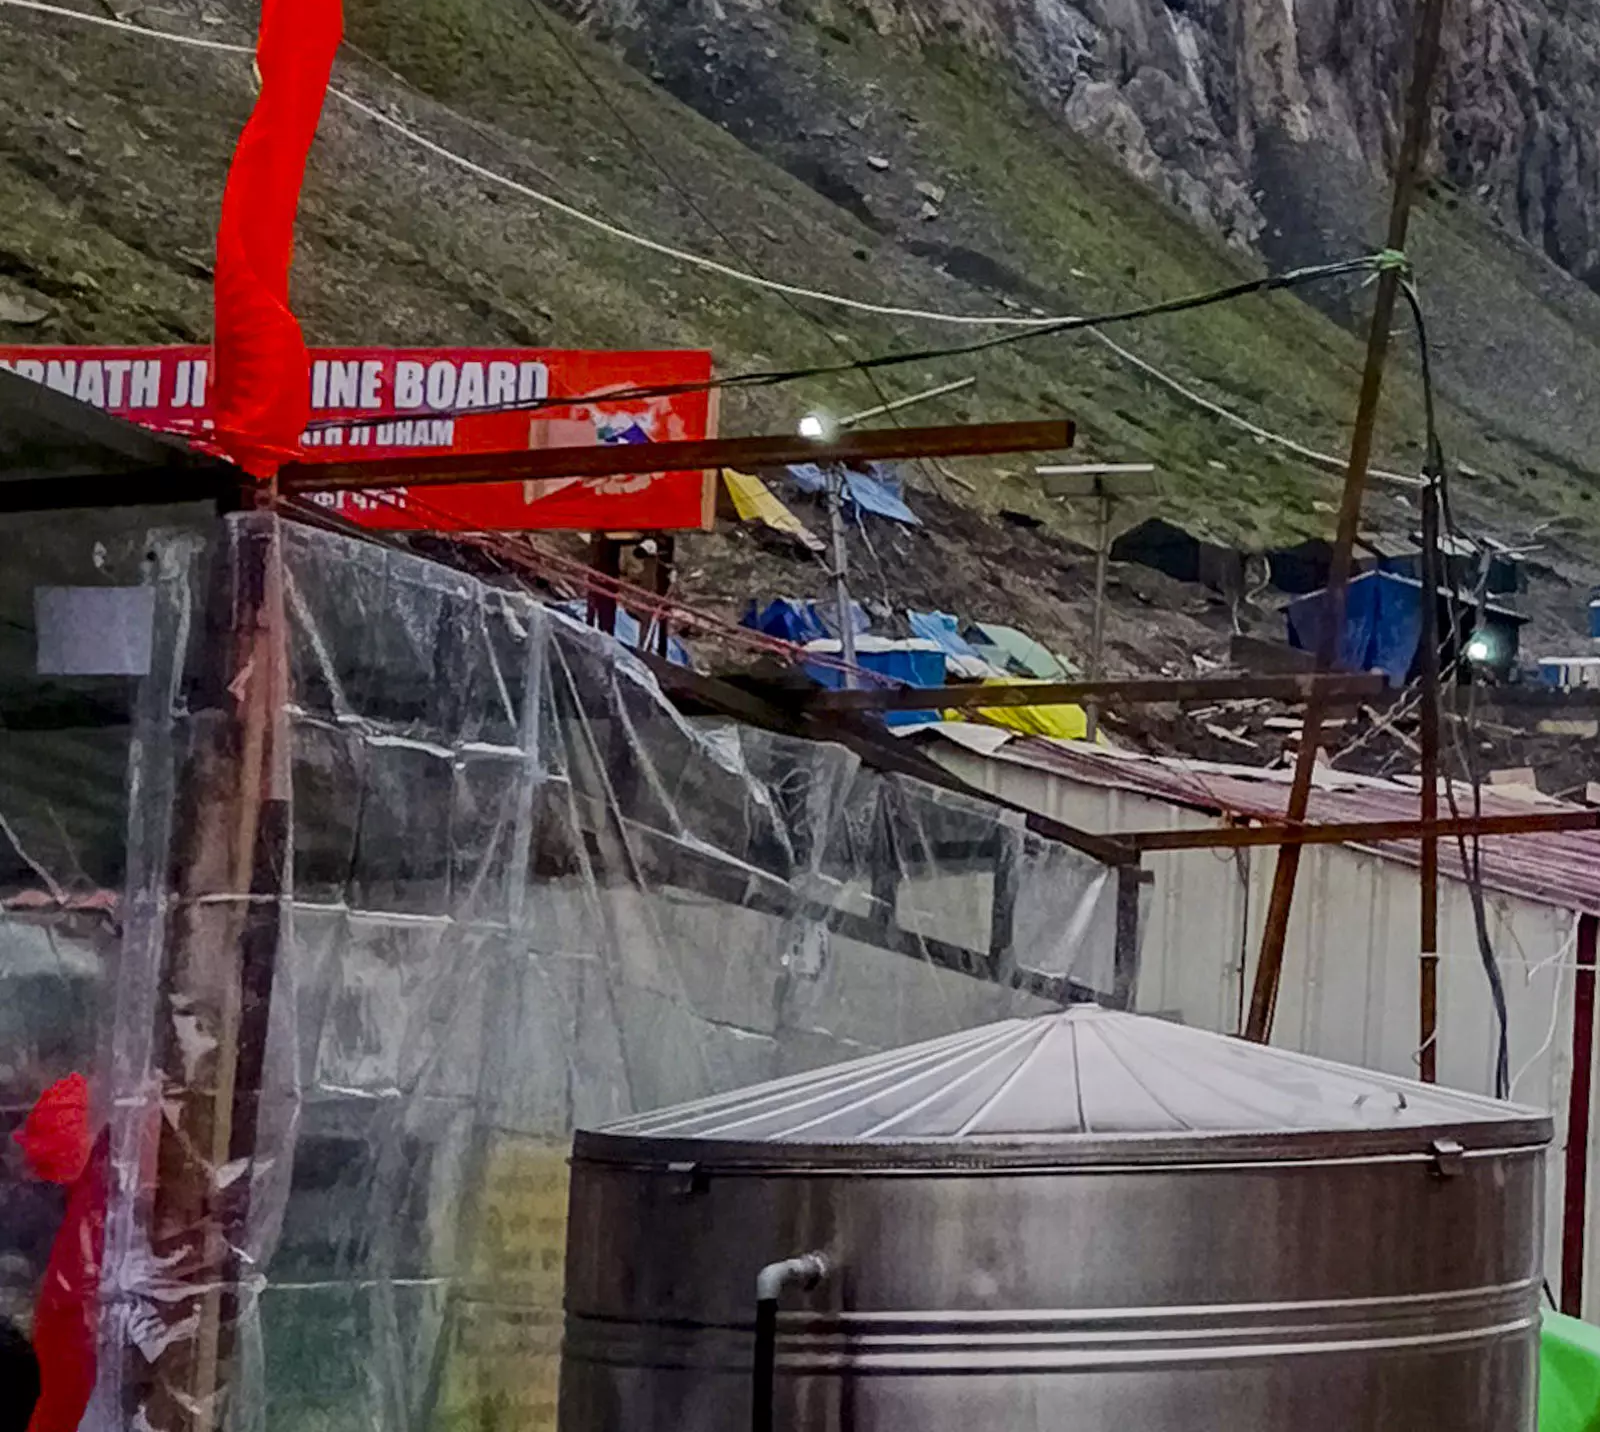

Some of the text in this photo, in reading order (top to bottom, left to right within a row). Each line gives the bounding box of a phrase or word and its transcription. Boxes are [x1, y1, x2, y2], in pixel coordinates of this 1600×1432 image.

[0, 360, 549, 409] NATH JI INE BOARD
[376, 420, 455, 447] DHAM
